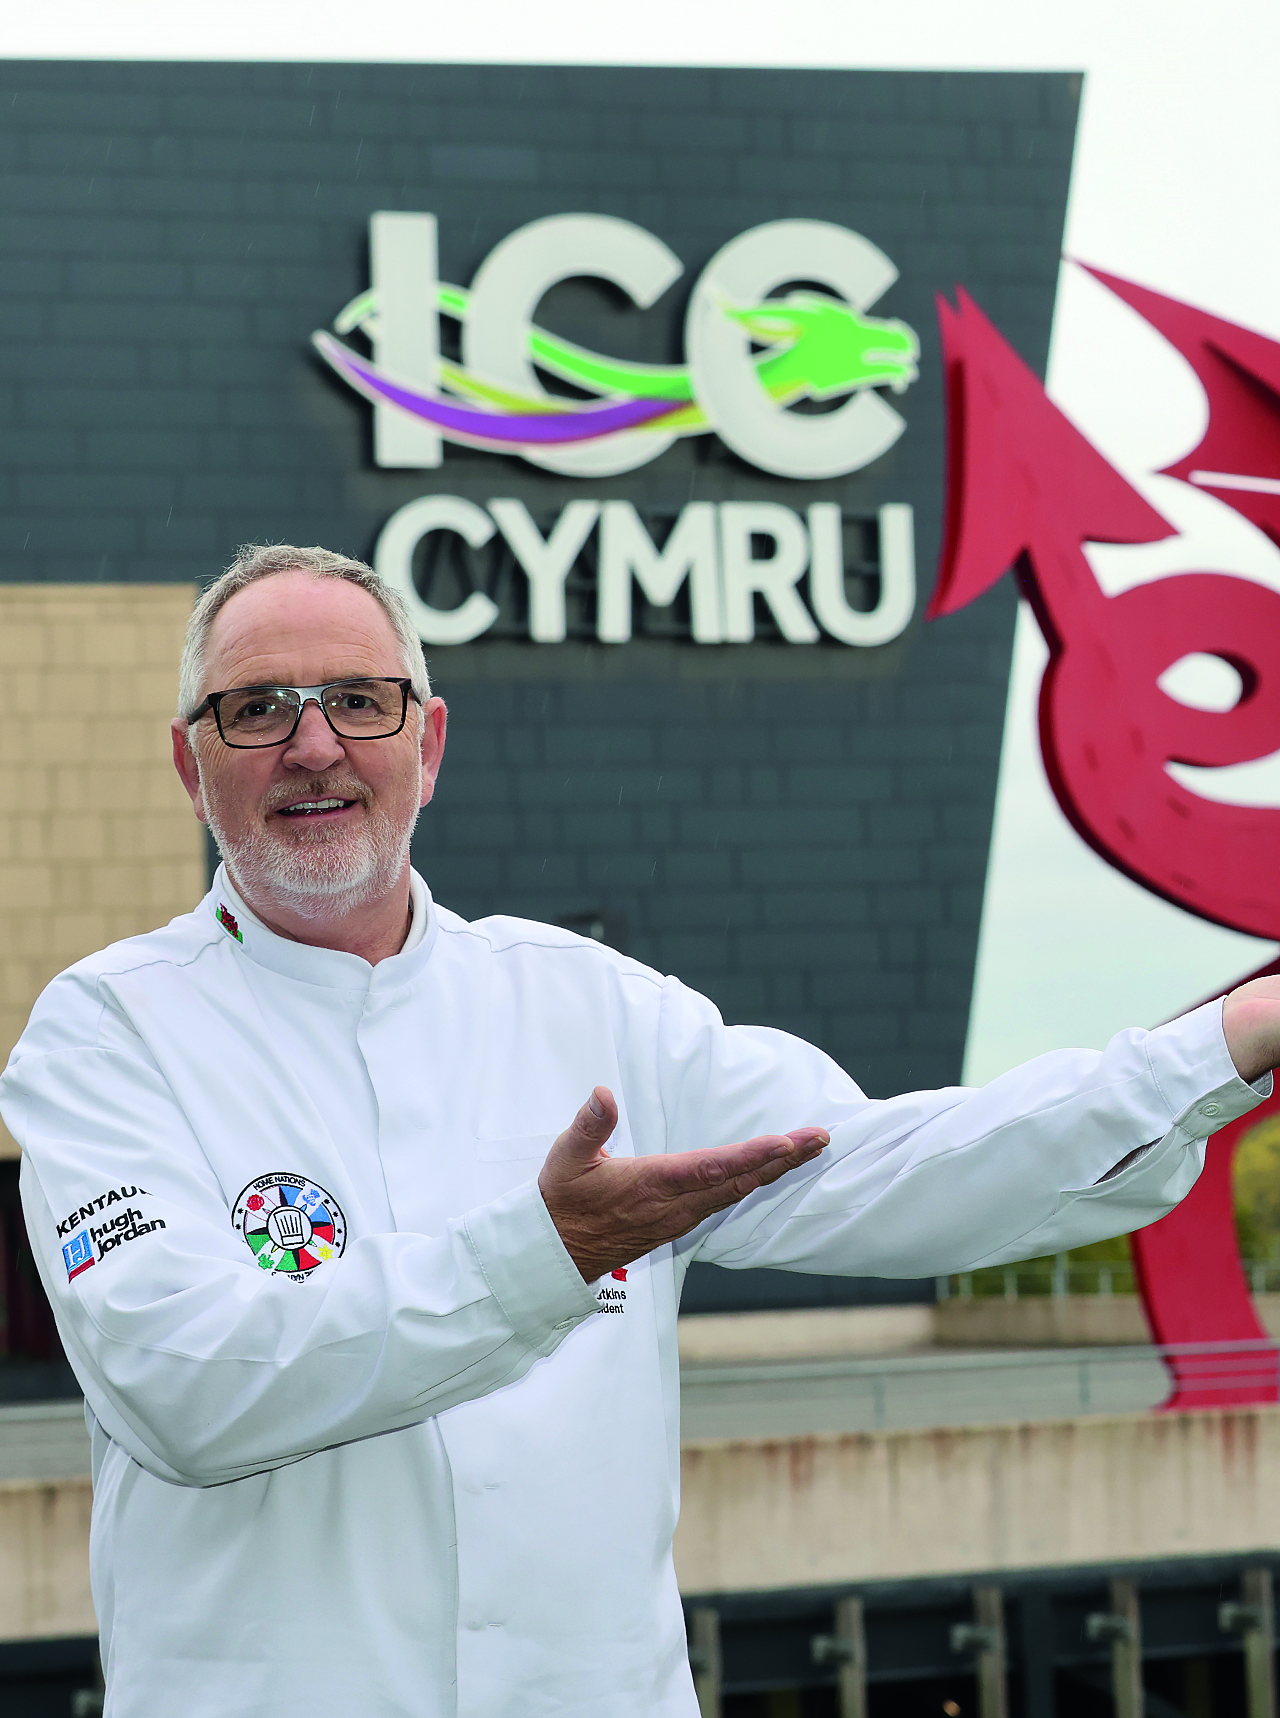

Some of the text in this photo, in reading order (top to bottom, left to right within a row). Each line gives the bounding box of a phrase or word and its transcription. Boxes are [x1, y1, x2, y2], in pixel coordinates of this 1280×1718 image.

[370, 211, 907, 480] ICC
[373, 494, 917, 648] CYMRU
[252, 1175, 306, 1191] HOME NATIONS
[90, 1208, 143, 1243] hugh
[97, 1219, 166, 1262] jordan
